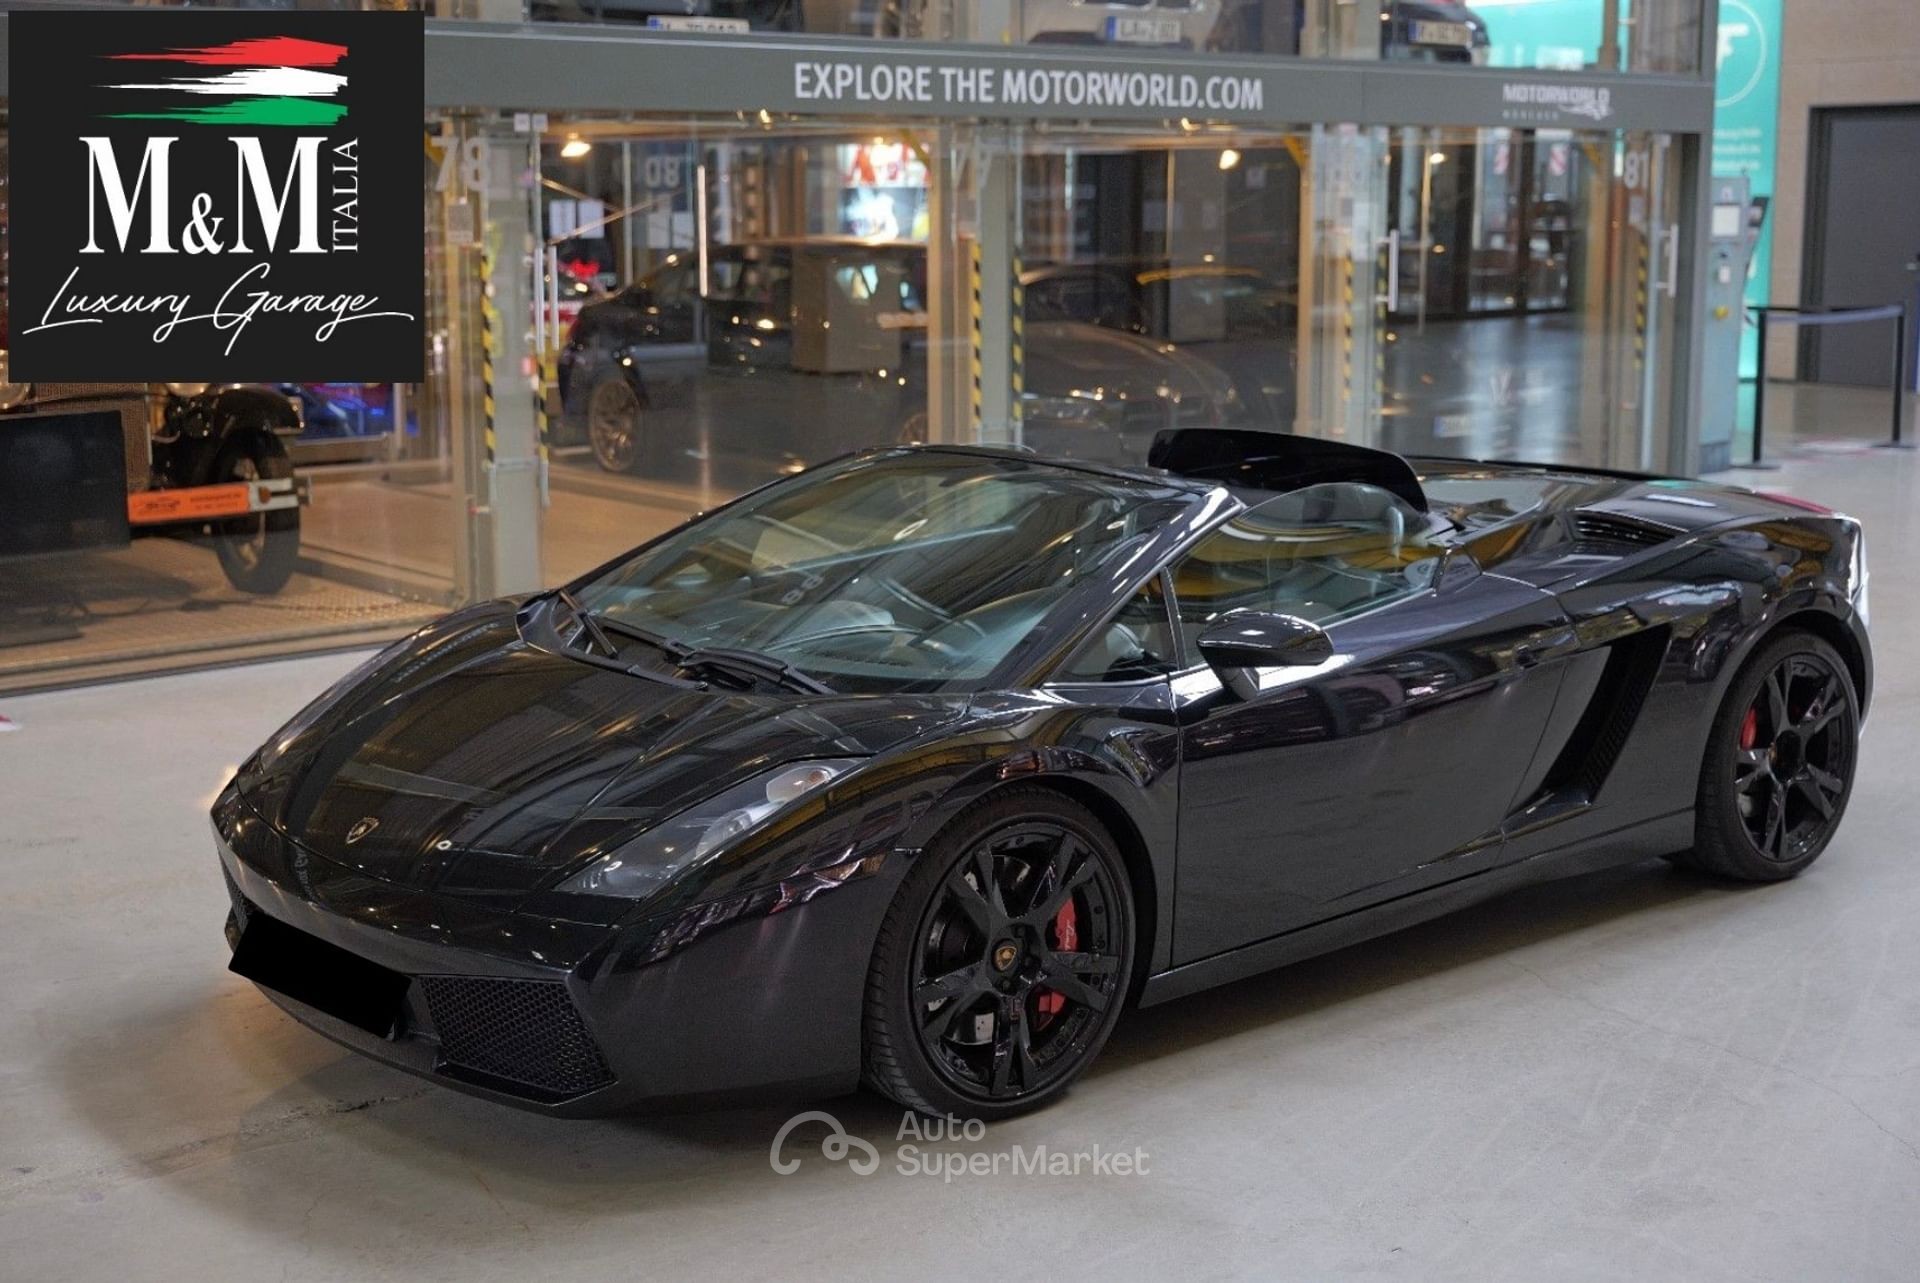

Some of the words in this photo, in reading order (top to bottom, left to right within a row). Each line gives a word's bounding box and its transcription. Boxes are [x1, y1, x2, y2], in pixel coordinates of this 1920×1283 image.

[794, 62, 933, 102] EXPLORE
[939, 66, 995, 103] THE
[1001, 69, 1264, 111] MOTORWORLD.COM
[431, 136, 490, 192] 78
